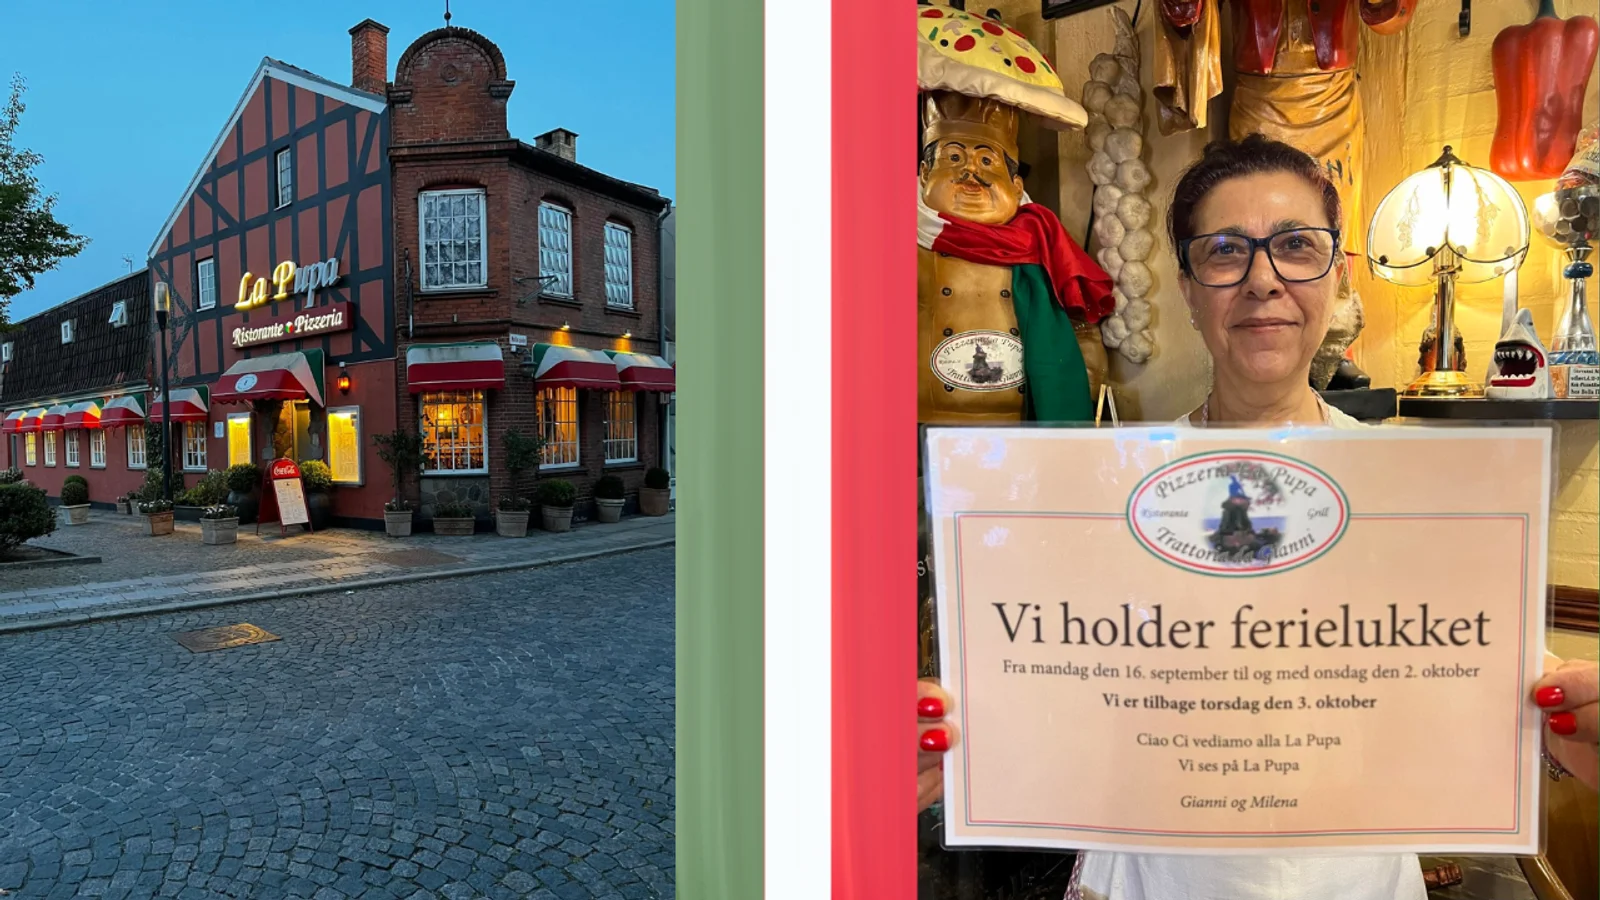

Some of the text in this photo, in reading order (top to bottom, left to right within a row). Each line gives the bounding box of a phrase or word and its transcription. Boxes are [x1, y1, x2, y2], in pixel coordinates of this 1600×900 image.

[234, 258, 340, 310] La Pupa
[232, 308, 343, 346] Ristorante Pizzeria
[1154, 460, 1229, 500] Pizzeria
[1270, 467, 1318, 498] Pupa
[1307, 507, 1330, 519] Grill
[1155, 525, 1229, 563] Trattoria
[1257, 527, 1316, 565] Gianni
[991, 601, 1492, 650] Vi holder ferielukket
[1002, 659, 1481, 684] Fra mandag den 16. september til og med onsdag den 2. oktober
[1102, 692, 1378, 715] Vi er tilbage torsdag den 3. oktober
[1136, 732, 1342, 752] Ciao Ci vediamo alla La Pupa
[1178, 758, 1300, 777] Vi ses på La Pupa
[1180, 794, 1298, 813] Gianni og Milena
